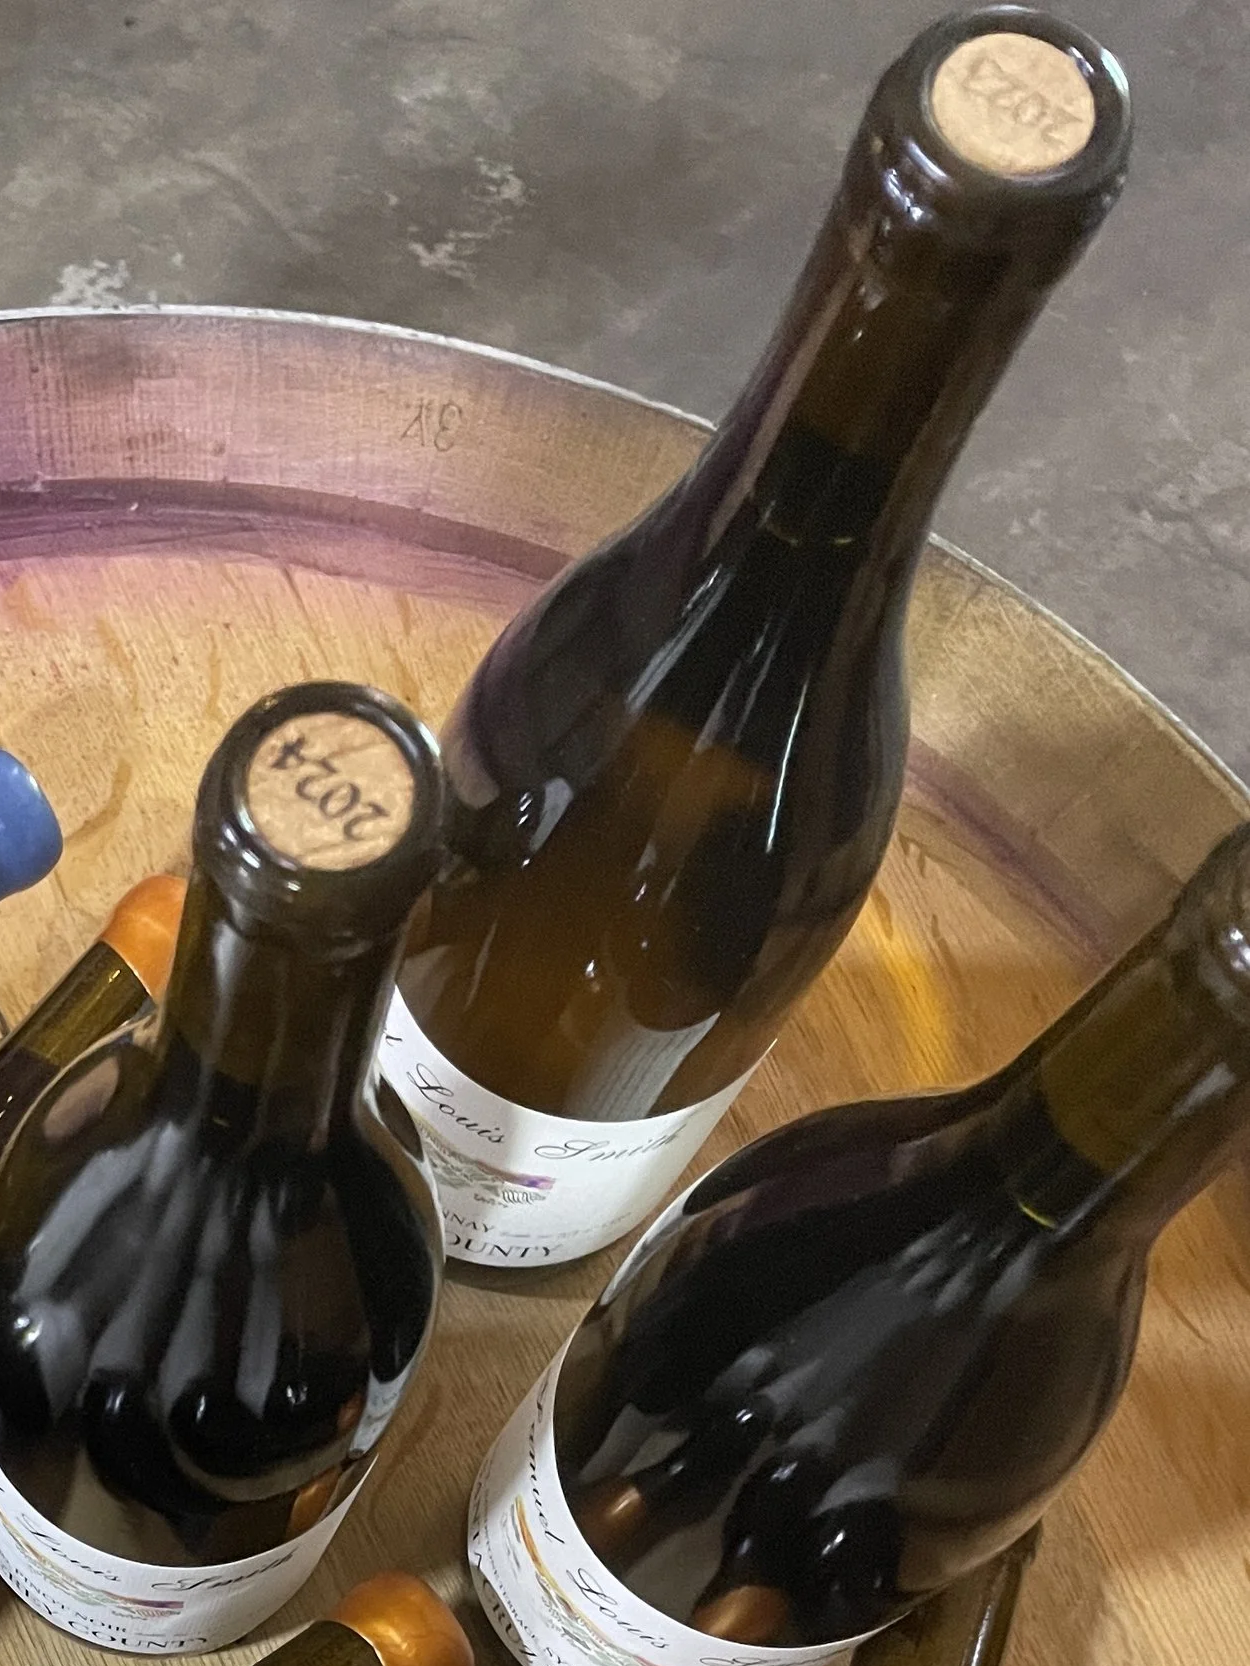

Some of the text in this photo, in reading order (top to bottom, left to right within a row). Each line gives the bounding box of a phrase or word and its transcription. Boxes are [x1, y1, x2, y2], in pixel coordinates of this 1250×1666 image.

[270, 734, 390, 842] 2024
[407, 1063, 505, 1145] Louis
[534, 1119, 688, 1163] Smith
[13, 1510, 300, 1593] Louis Smith
[565, 1565, 669, 1650] Louis
